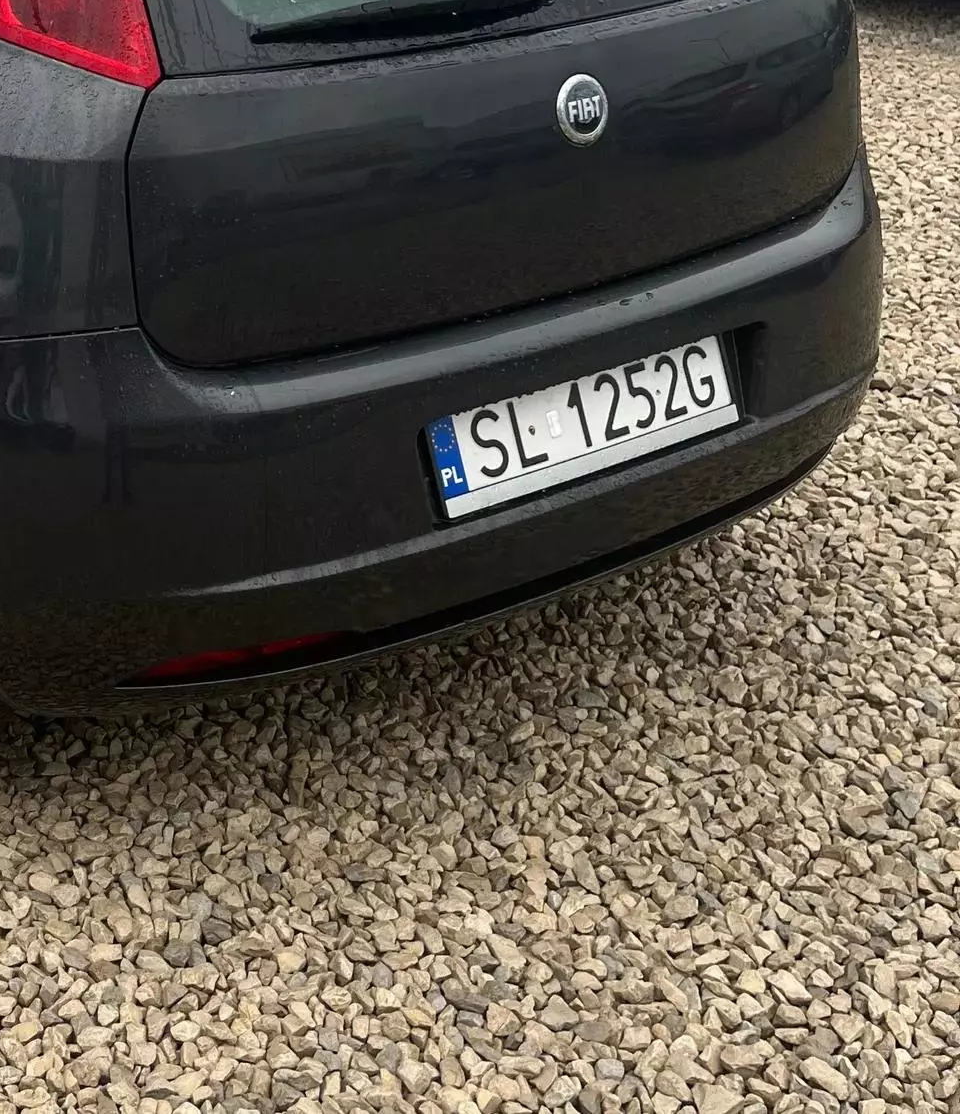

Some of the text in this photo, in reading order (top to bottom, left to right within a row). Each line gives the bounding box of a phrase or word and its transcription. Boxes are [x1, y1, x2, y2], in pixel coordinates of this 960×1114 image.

[568, 95, 601, 124] FIAT
[441, 345, 716, 488] PL SL 1252G
